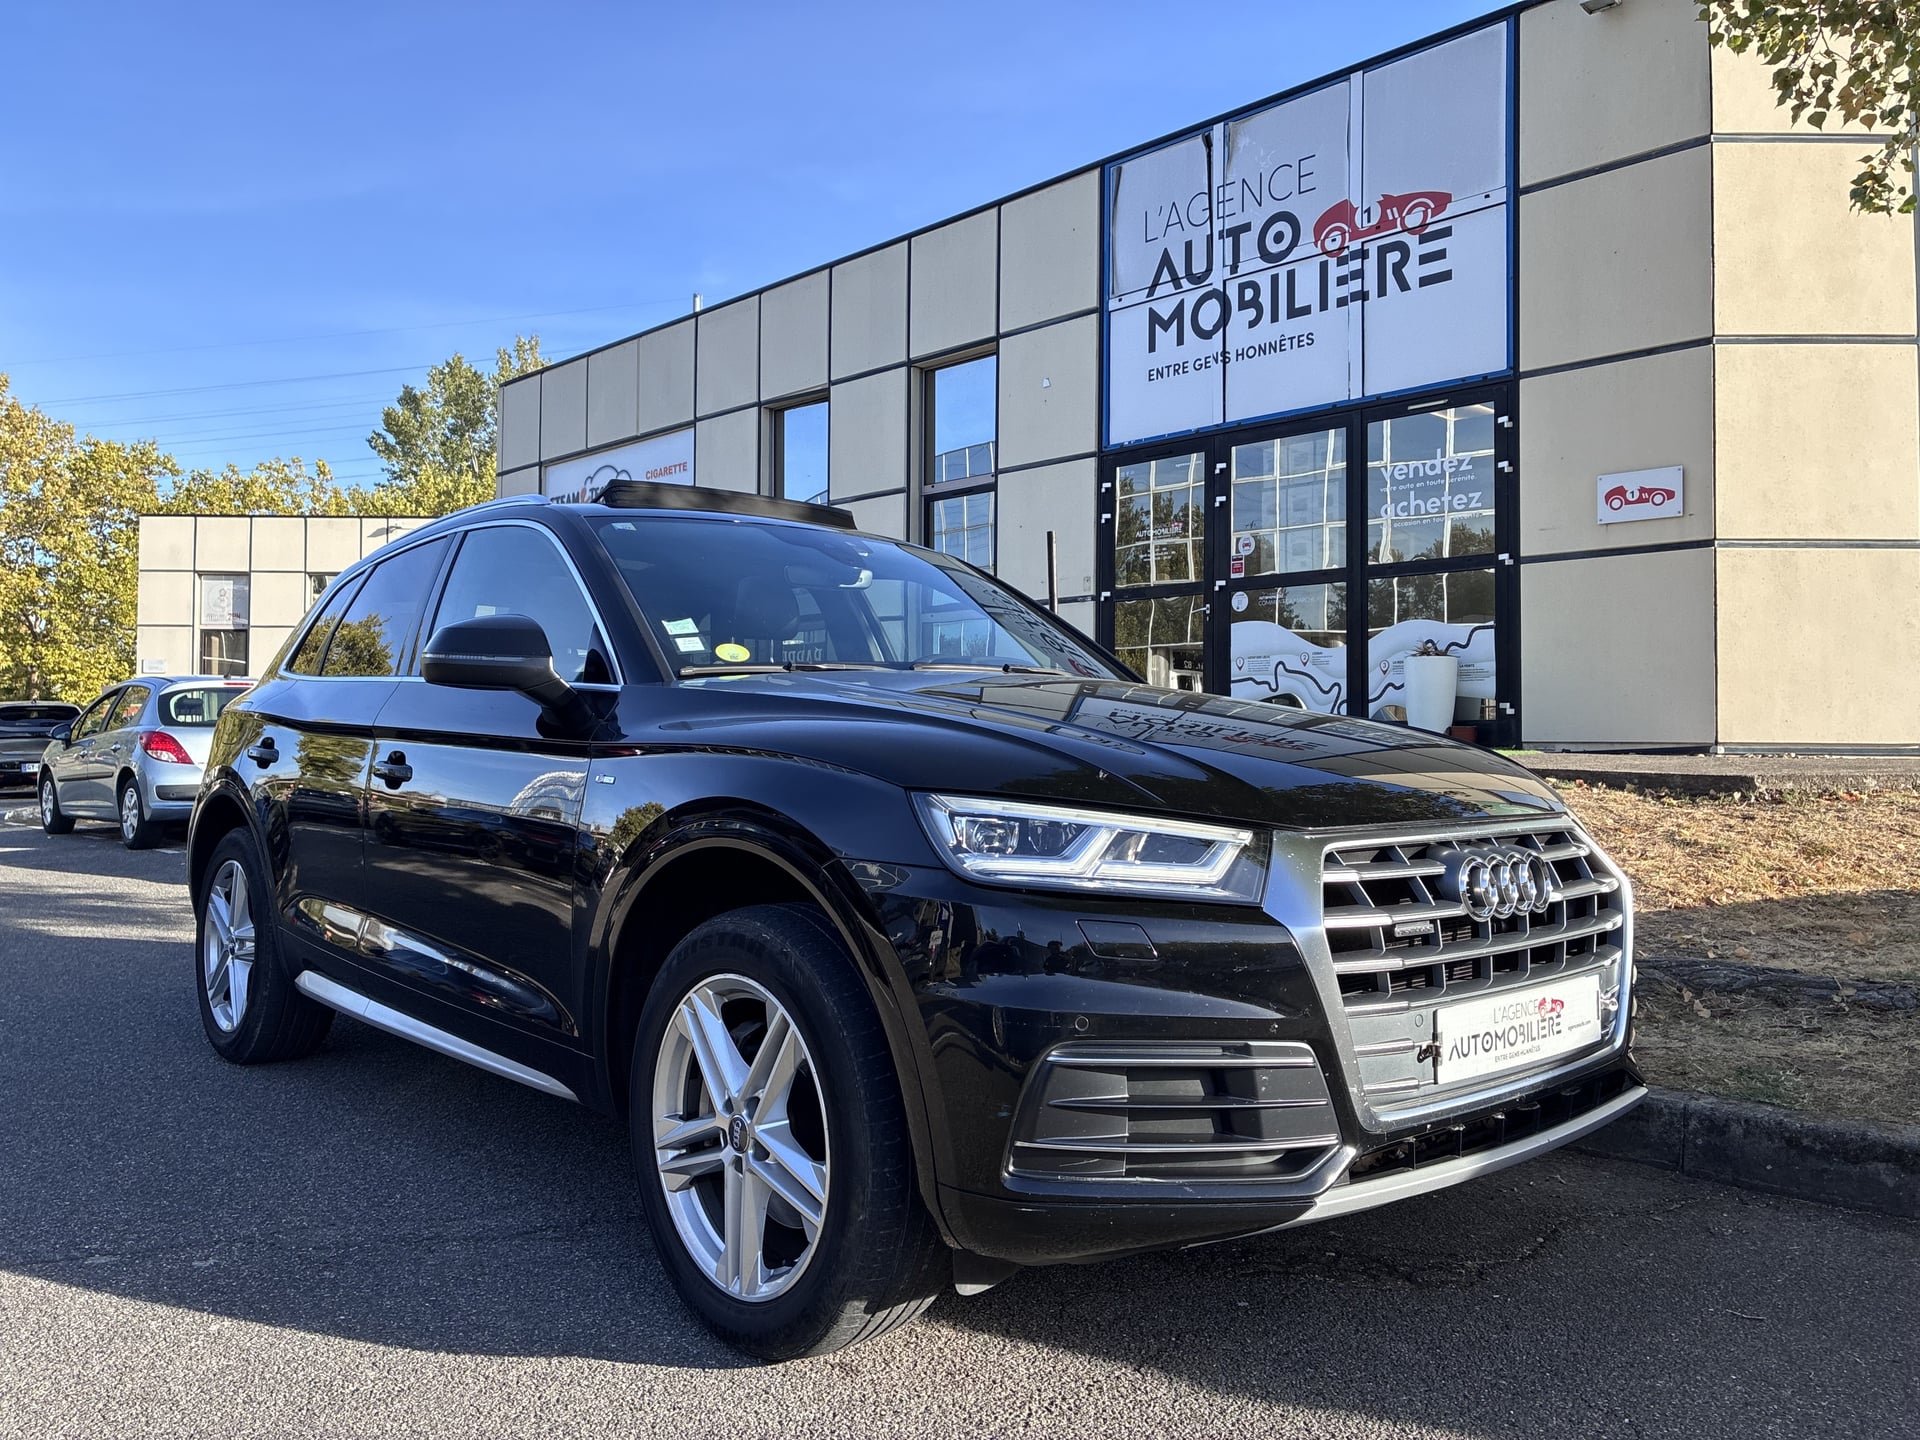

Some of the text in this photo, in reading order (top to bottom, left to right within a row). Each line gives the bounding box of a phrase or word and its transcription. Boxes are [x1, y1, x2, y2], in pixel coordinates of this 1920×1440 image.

[1144, 154, 1317, 243] L'AGENCE
[1146, 210, 1301, 299] AUTO
[1147, 332, 1316, 382] ENTRE GENS HONNÊTES
[645, 461, 688, 481] CIGARETTE
[1380, 448, 1473, 481] vendez
[1398, 482, 1415, 491] auto
[1380, 490, 1483, 519] achetez
[1493, 998, 1538, 1024] L'AGENCE
